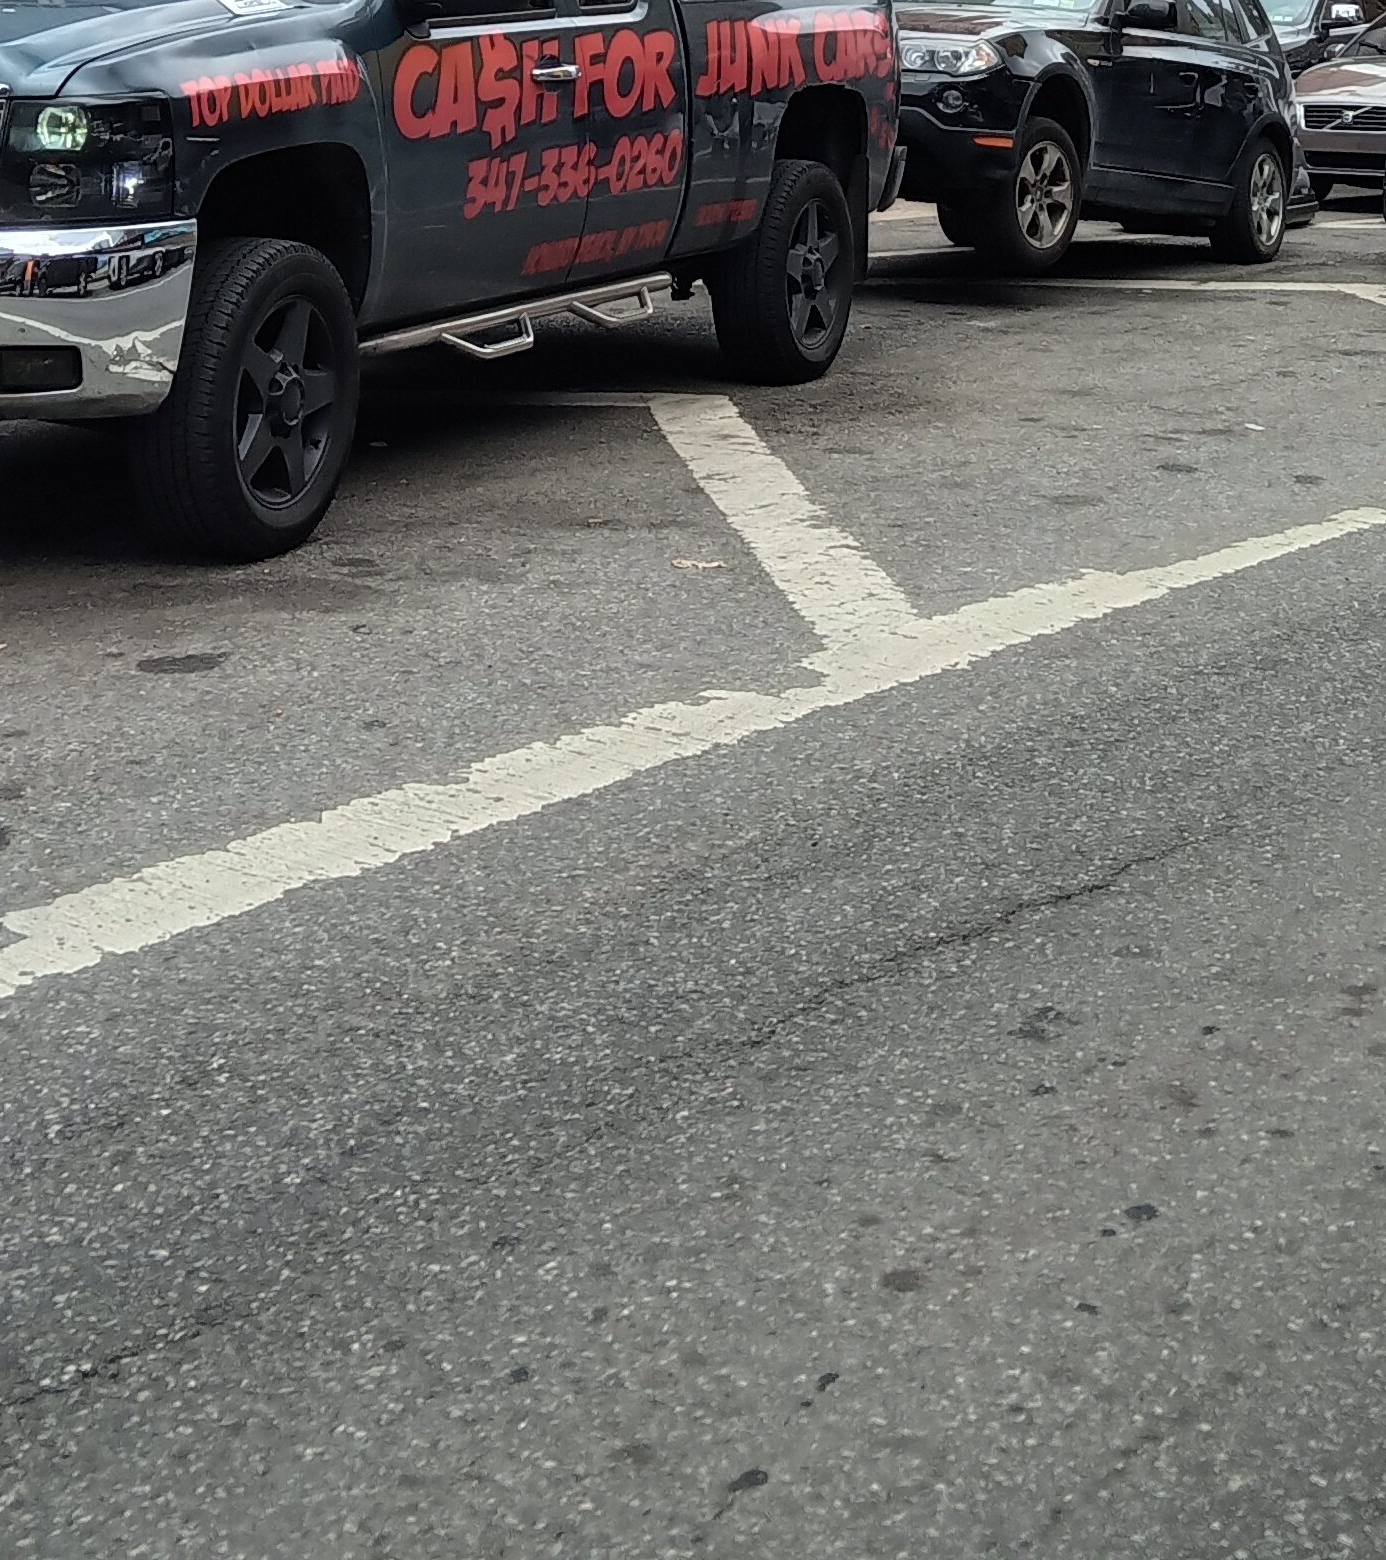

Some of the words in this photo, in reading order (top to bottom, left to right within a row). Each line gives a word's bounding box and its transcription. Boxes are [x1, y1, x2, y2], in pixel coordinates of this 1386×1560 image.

[179, 75, 235, 128] TOP
[234, 66, 317, 120] DOLLAR
[315, 57, 361, 106] PAID
[392, 29, 560, 150] CA$H
[572, 28, 677, 119] FOR
[695, 16, 807, 97] JUNK
[813, 10, 893, 82] CARS
[463, 127, 684, 220] 347-336-0260
